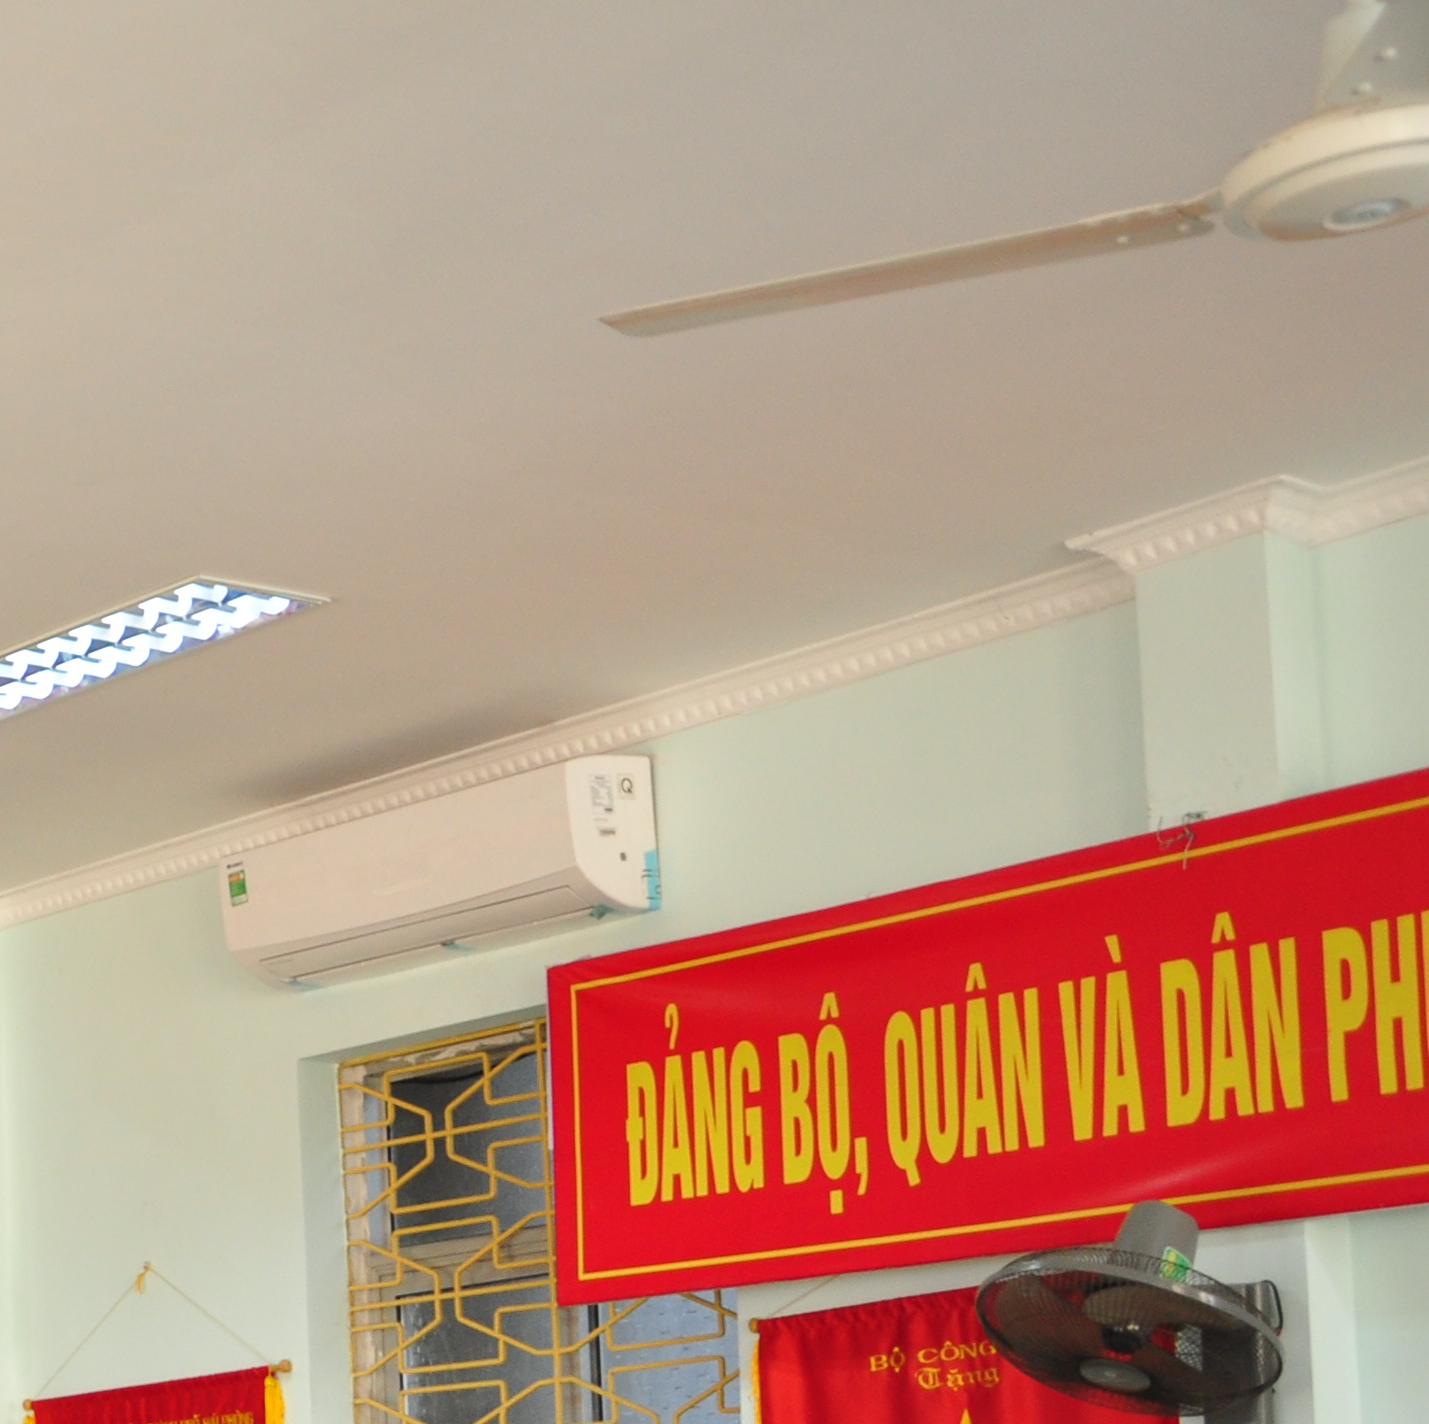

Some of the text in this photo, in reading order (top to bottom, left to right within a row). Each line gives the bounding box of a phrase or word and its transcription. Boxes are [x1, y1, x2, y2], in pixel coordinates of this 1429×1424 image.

[626, 909, 1429, 1214] ĐẢNG BỘ, QUÂN VÀ DÂN PH
[869, 1340, 997, 1373] BỘ CÔNG
[914, 1366, 1000, 1392] Tặng
